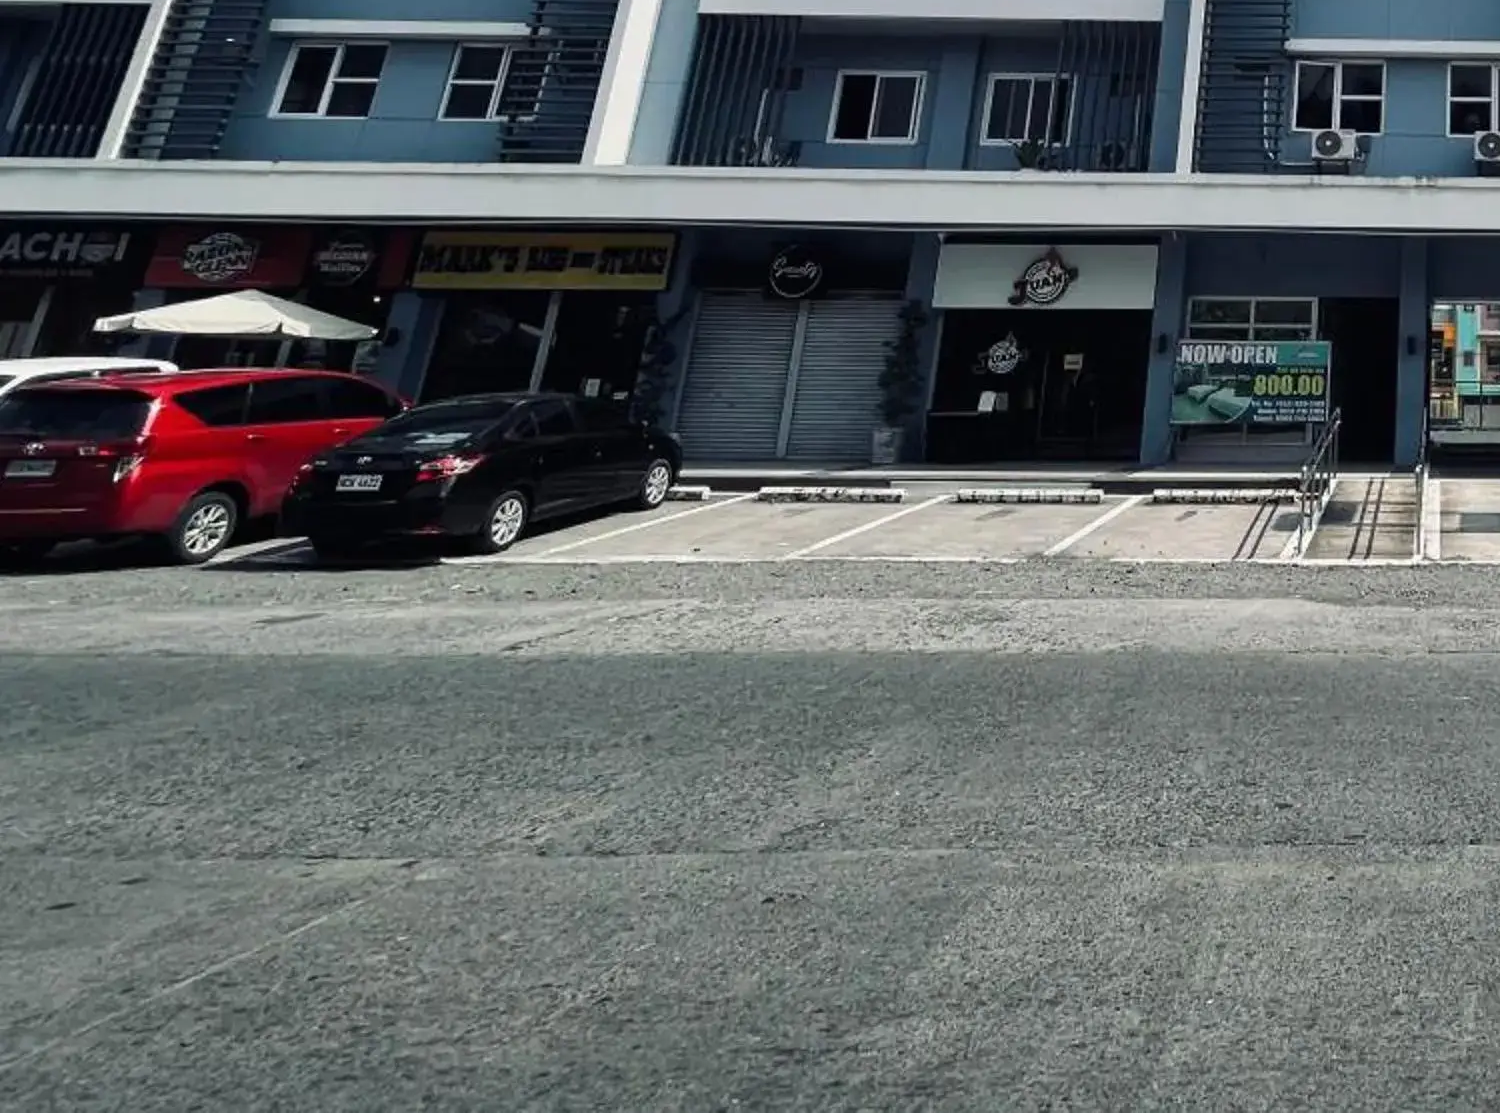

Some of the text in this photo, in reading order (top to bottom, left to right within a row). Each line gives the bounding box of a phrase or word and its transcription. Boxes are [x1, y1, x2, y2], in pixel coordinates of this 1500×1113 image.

[1181, 344, 1227, 364] NOW
[1230, 344, 1278, 364] OPEN
[1252, 374, 1325, 396] 800.00
